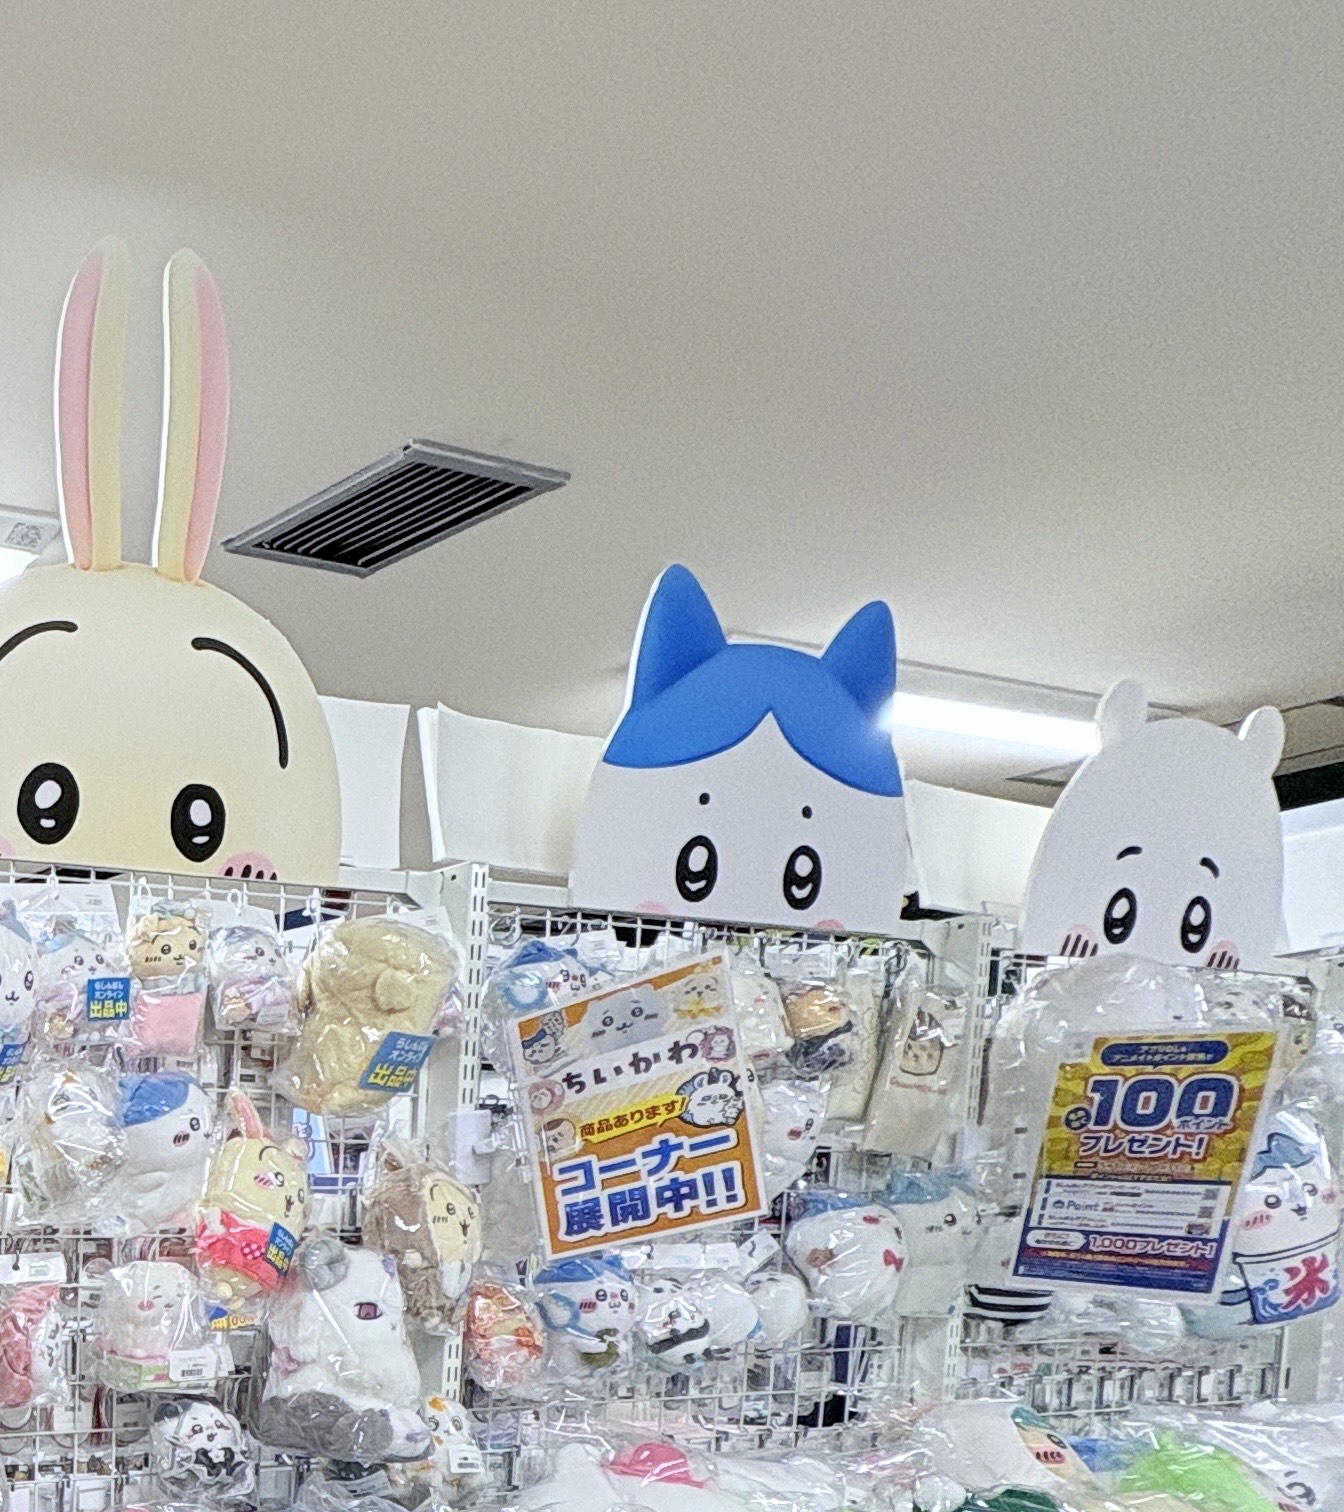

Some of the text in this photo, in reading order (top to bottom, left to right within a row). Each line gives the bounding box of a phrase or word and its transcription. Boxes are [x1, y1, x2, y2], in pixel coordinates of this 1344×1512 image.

[89, 999, 128, 1019] 出品中
[562, 1040, 700, 1095] ちいかわ
[579, 1099, 686, 1138] 商品あります!
[1089, 1076, 1236, 1129] 100
[558, 1133, 732, 1196] コーナー
[1080, 1135, 1207, 1157] プレゼント!
[563, 1166, 739, 1237] 展開中!!
[1283, 1254, 1331, 1312] 氷
